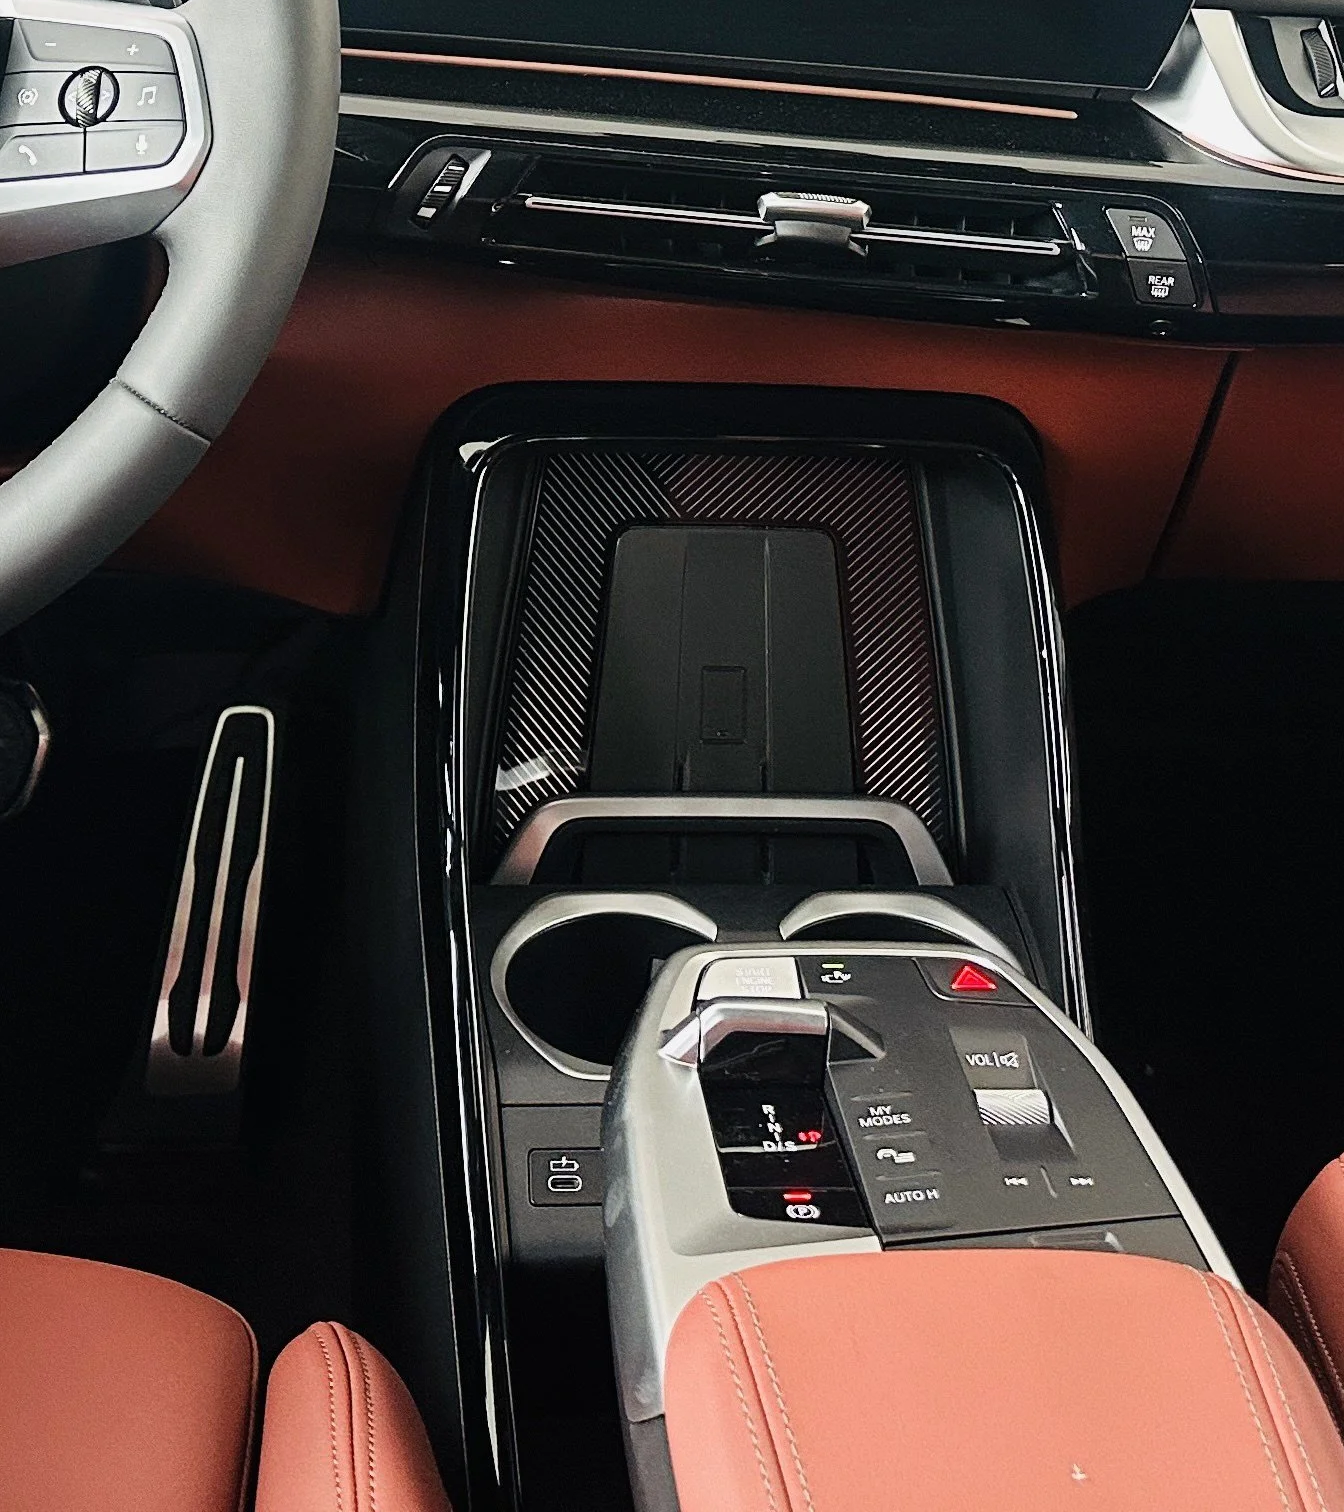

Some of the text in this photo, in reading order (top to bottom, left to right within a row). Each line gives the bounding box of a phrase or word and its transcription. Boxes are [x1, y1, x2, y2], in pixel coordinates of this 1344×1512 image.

[1132, 225, 1156, 238] MAX
[1148, 275, 1175, 287] REAR
[966, 1053, 994, 1067] VOL
[868, 1105, 892, 1116] MY
[858, 1113, 912, 1128] MODES
[884, 1189, 940, 1204] AUTO H
